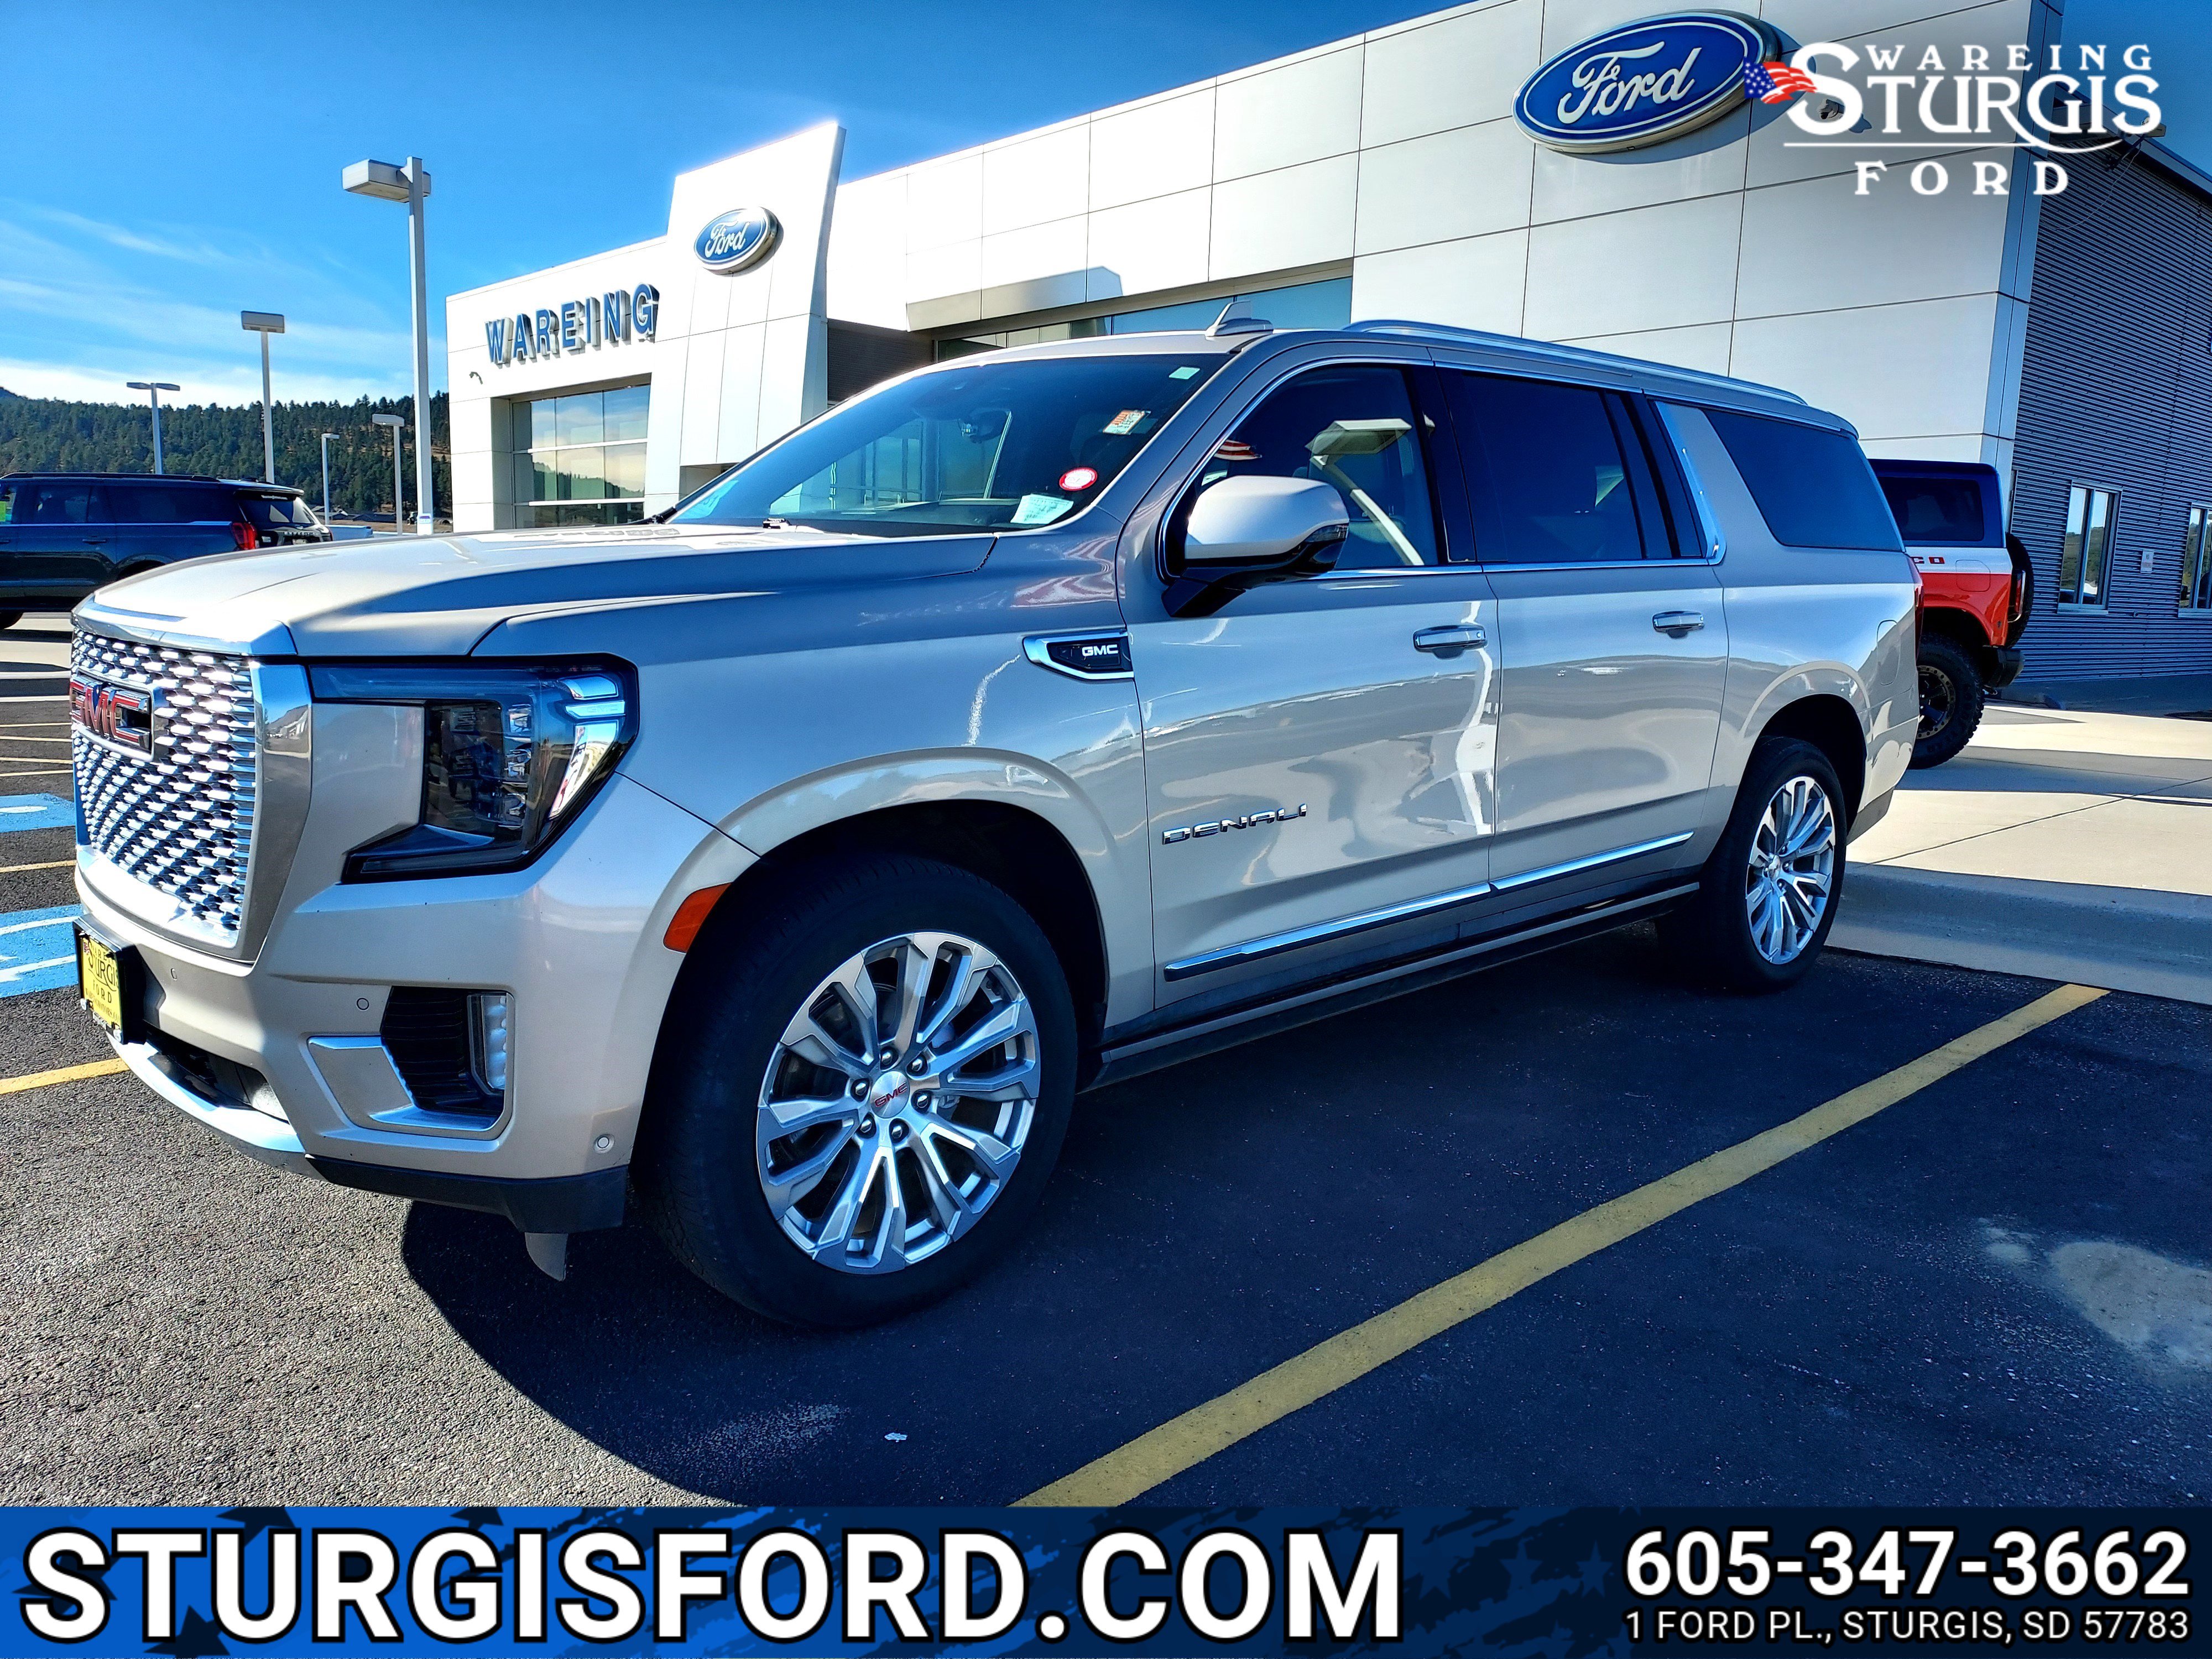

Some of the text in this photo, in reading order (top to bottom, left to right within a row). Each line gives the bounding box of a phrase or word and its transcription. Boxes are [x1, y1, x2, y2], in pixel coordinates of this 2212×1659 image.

[1557, 41, 1695, 123] Ford
[705, 220, 750, 258] Ford
[485, 283, 659, 365] WAREING
[1082, 644, 1119, 656] GMC
[70, 677, 145, 747] GMC
[1162, 803, 1307, 845] DENALI
[93, 979, 112, 1004] FORD
[875, 1082, 907, 1107] GMC
